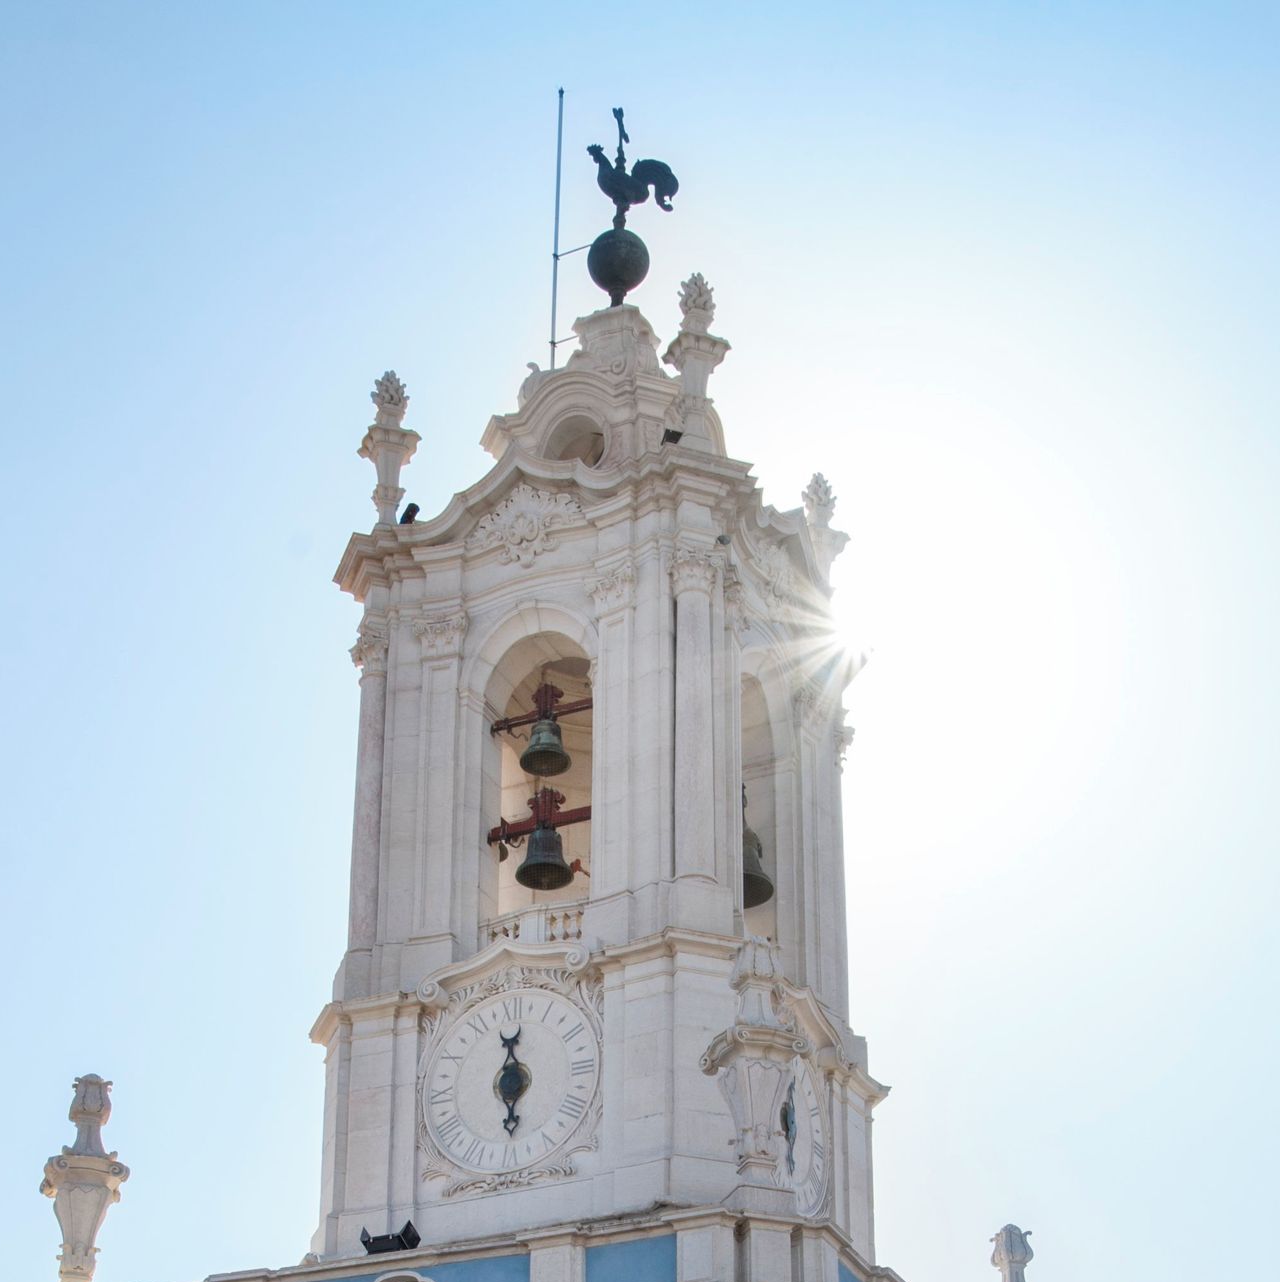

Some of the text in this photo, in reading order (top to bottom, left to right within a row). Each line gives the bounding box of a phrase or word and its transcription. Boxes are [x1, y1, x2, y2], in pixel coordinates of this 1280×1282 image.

[501, 997, 522, 1023] XII
[541, 1001, 554, 1022] I
[467, 1013, 489, 1039] XI
[562, 1022, 584, 1043] II
[440, 1049, 463, 1067] X
[570, 1058, 594, 1076] III
